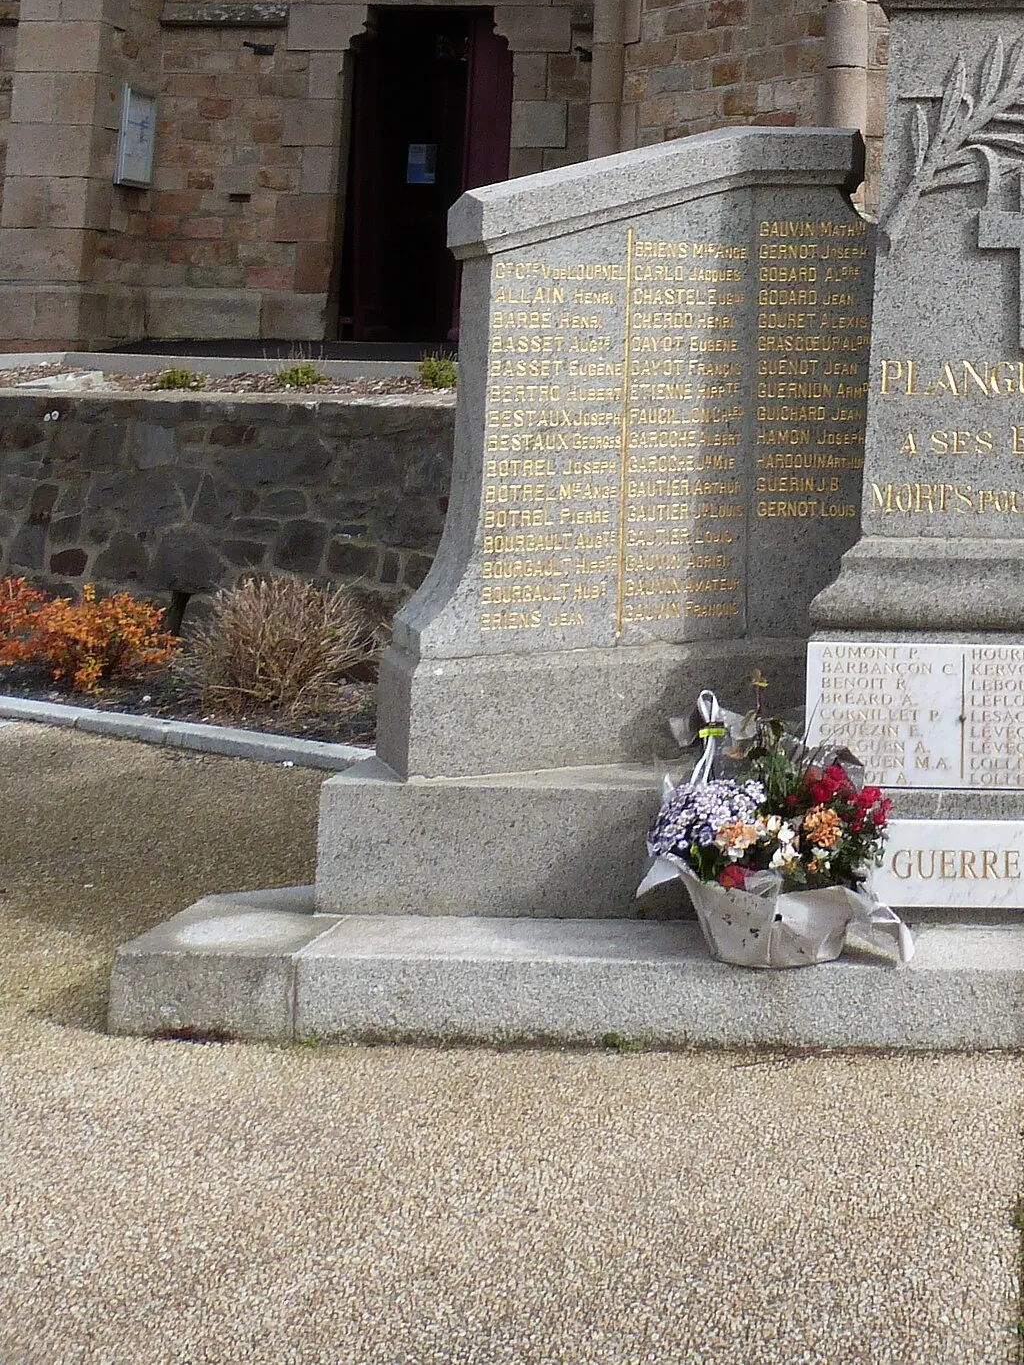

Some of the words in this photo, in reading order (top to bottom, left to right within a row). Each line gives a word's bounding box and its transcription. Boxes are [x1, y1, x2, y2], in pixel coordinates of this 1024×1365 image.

[760, 221, 814, 236] GAUVIN
[635, 242, 688, 258] BRIENS
[760, 244, 818, 259] GERNOT
[634, 266, 684, 281] CARLO
[495, 287, 564, 304] ALLAIN
[633, 289, 706, 305] CHASTEL
[759, 313, 816, 328] GOURET
[492, 336, 564, 352] BASSET
[490, 360, 562, 376] BASSET
[488, 410, 572, 427] BESTAUX
[757, 406, 825, 420] GUICHARD
[487, 433, 568, 451] BESTAUX
[628, 431, 696, 448] GAROCHE
[757, 430, 809, 445] HAMON
[899, 433, 916, 454] A
[931, 430, 992, 454] SES
[486, 460, 556, 476] BOTREL
[628, 455, 694, 472] GAROCHE
[757, 454, 825, 468] HARDOUIN
[485, 485, 556, 503] BOTREL
[628, 480, 689, 497] GAUTIER
[872, 483, 972, 515] MORTS
[628, 503, 688, 522] GAUTIER
[757, 501, 817, 516] GERNOT
[484, 510, 554, 528] BOTREL
[484, 533, 572, 554] BOURGAULT
[626, 529, 689, 546] GAUTIER
[482, 558, 571, 579] BOURGAULT
[481, 584, 570, 604] BOURGAULT
[481, 611, 542, 631] BRIENS
[822, 647, 898, 658] AUMONT
[822, 677, 886, 689] BENOIT
[820, 709, 917, 721] CORNILLET
[891, 849, 1021, 880] GUERRE
